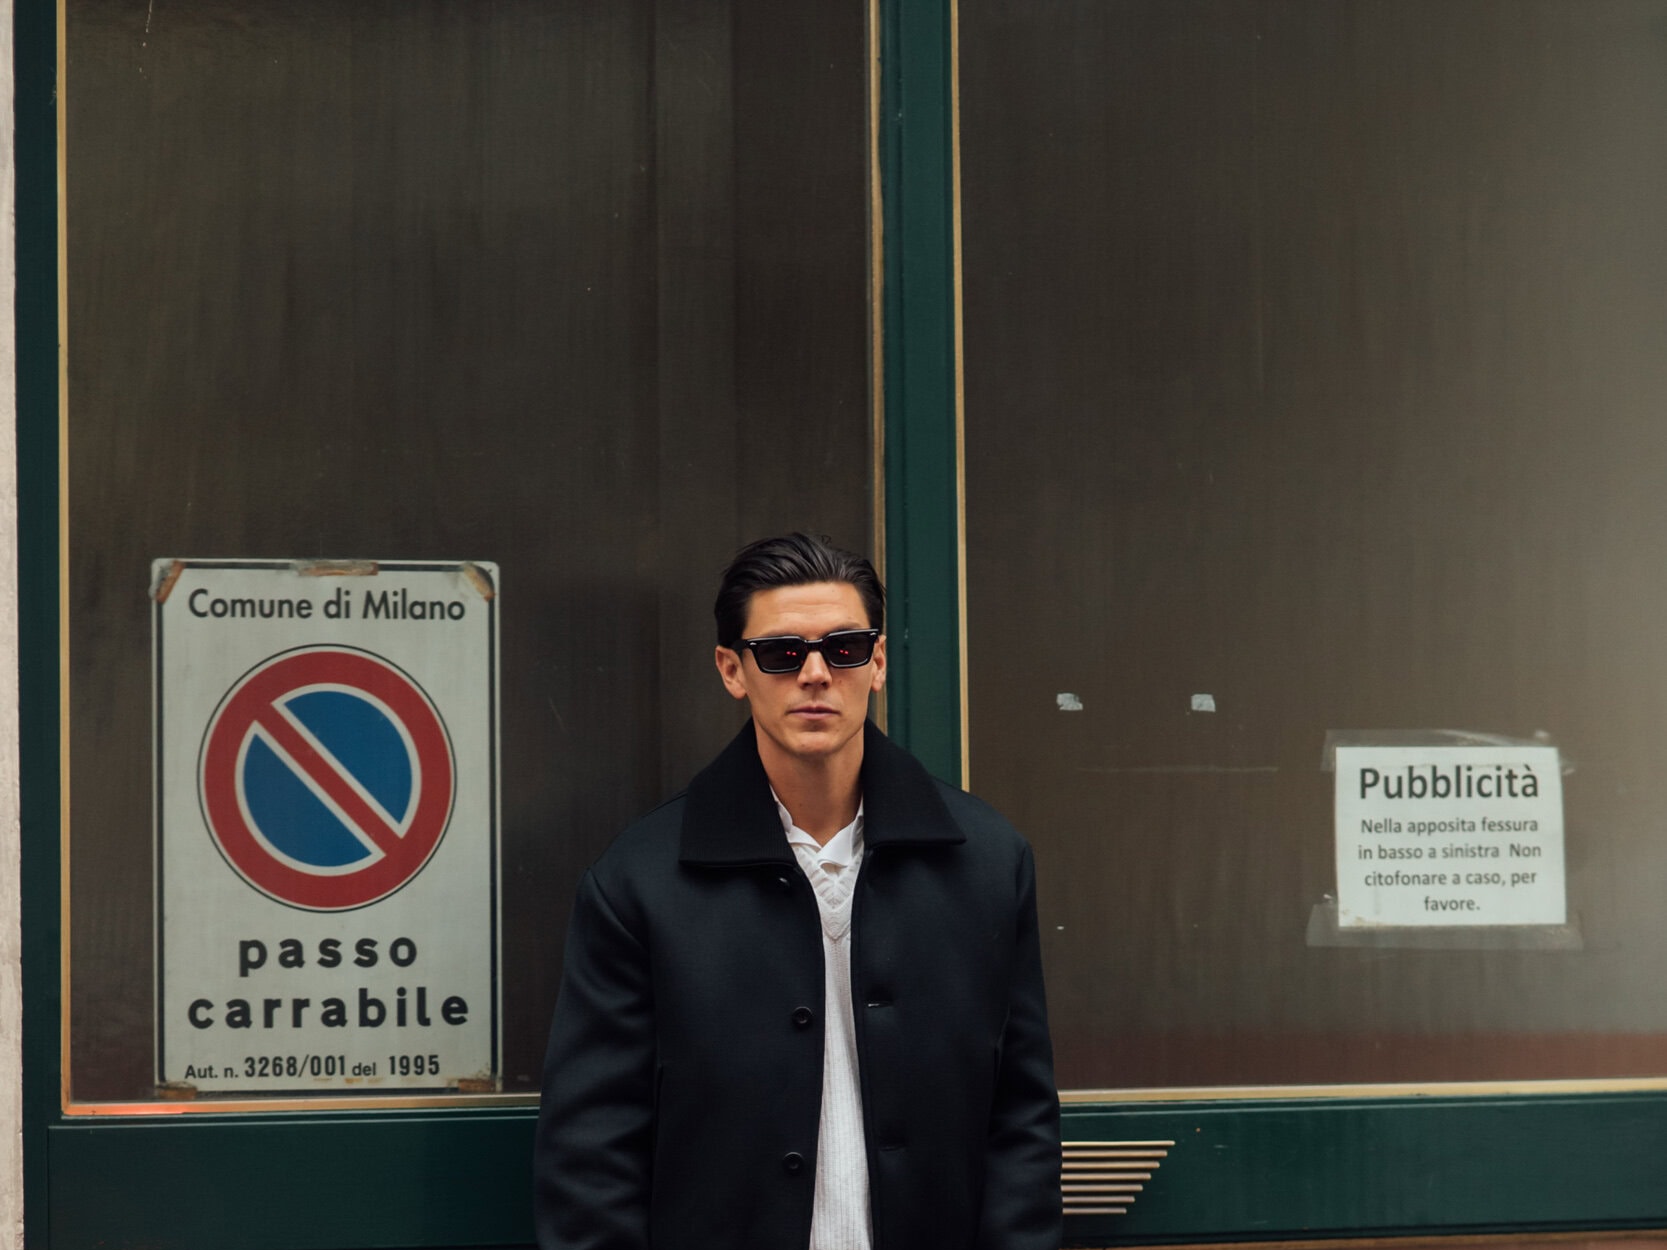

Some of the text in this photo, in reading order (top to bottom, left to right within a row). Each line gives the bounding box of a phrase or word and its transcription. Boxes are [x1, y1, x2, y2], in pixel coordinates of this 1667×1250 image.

[189, 588, 466, 621] Comune di Milano
[1359, 764, 1539, 799] Pubblicità
[1361, 816, 1539, 836] Nella apposita fessura
[1358, 843, 1542, 860] in basso a sinistra Non
[1364, 870, 1537, 887] citofonare a caso, per
[1424, 896, 1481, 911] favore.
[238, 937, 418, 977] passo
[188, 986, 469, 1029] carrabile
[184, 1054, 440, 1079] Aut. n. 3268/001 del 1995
